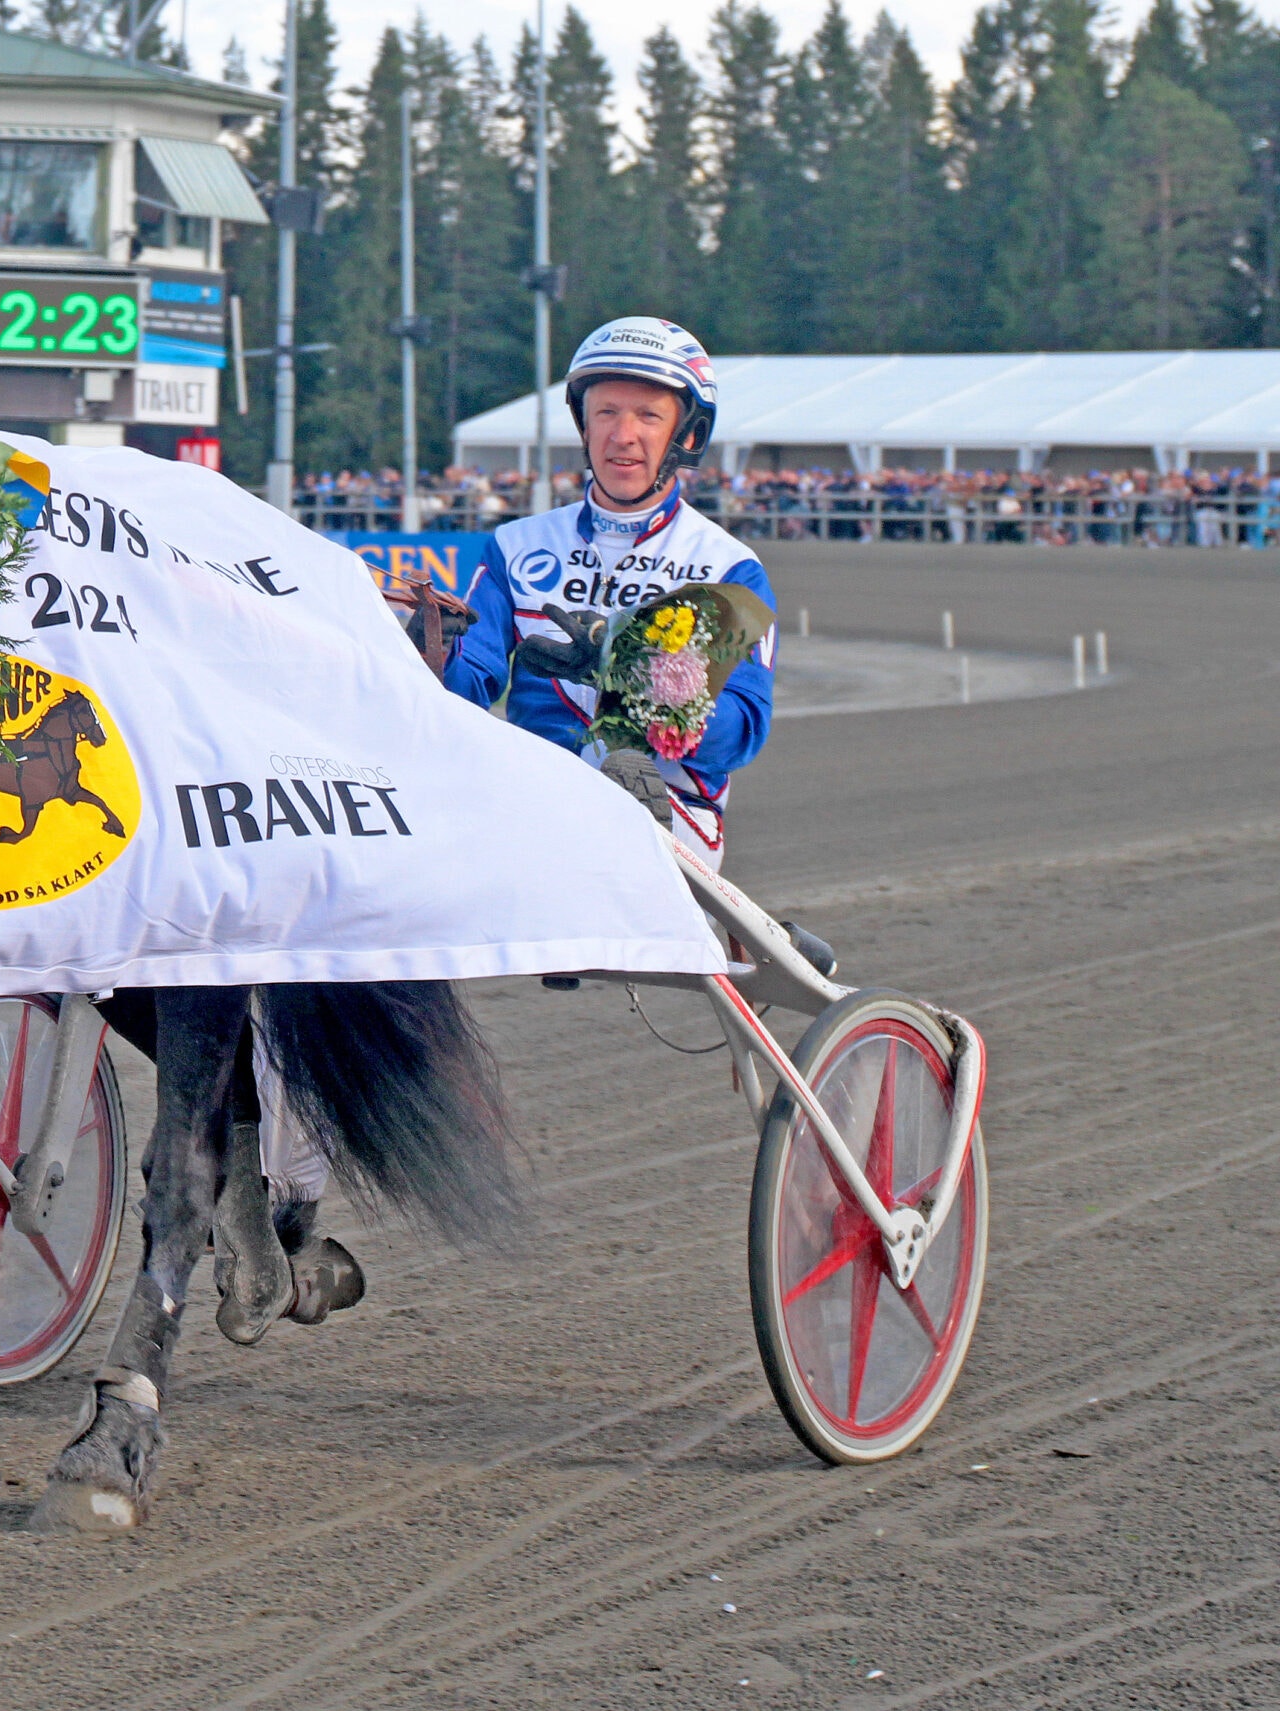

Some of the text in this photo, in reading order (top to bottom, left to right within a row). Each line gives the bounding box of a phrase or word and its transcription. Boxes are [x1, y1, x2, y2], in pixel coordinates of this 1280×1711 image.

[611, 333, 665, 351] elteam
[137, 379, 206, 414] TRAVET
[563, 572, 666, 608] eltea
[269, 751, 392, 785] ÖSTERSUNDS
[175, 779, 413, 848] TRAVET
[50, 852, 104, 893] KLART
